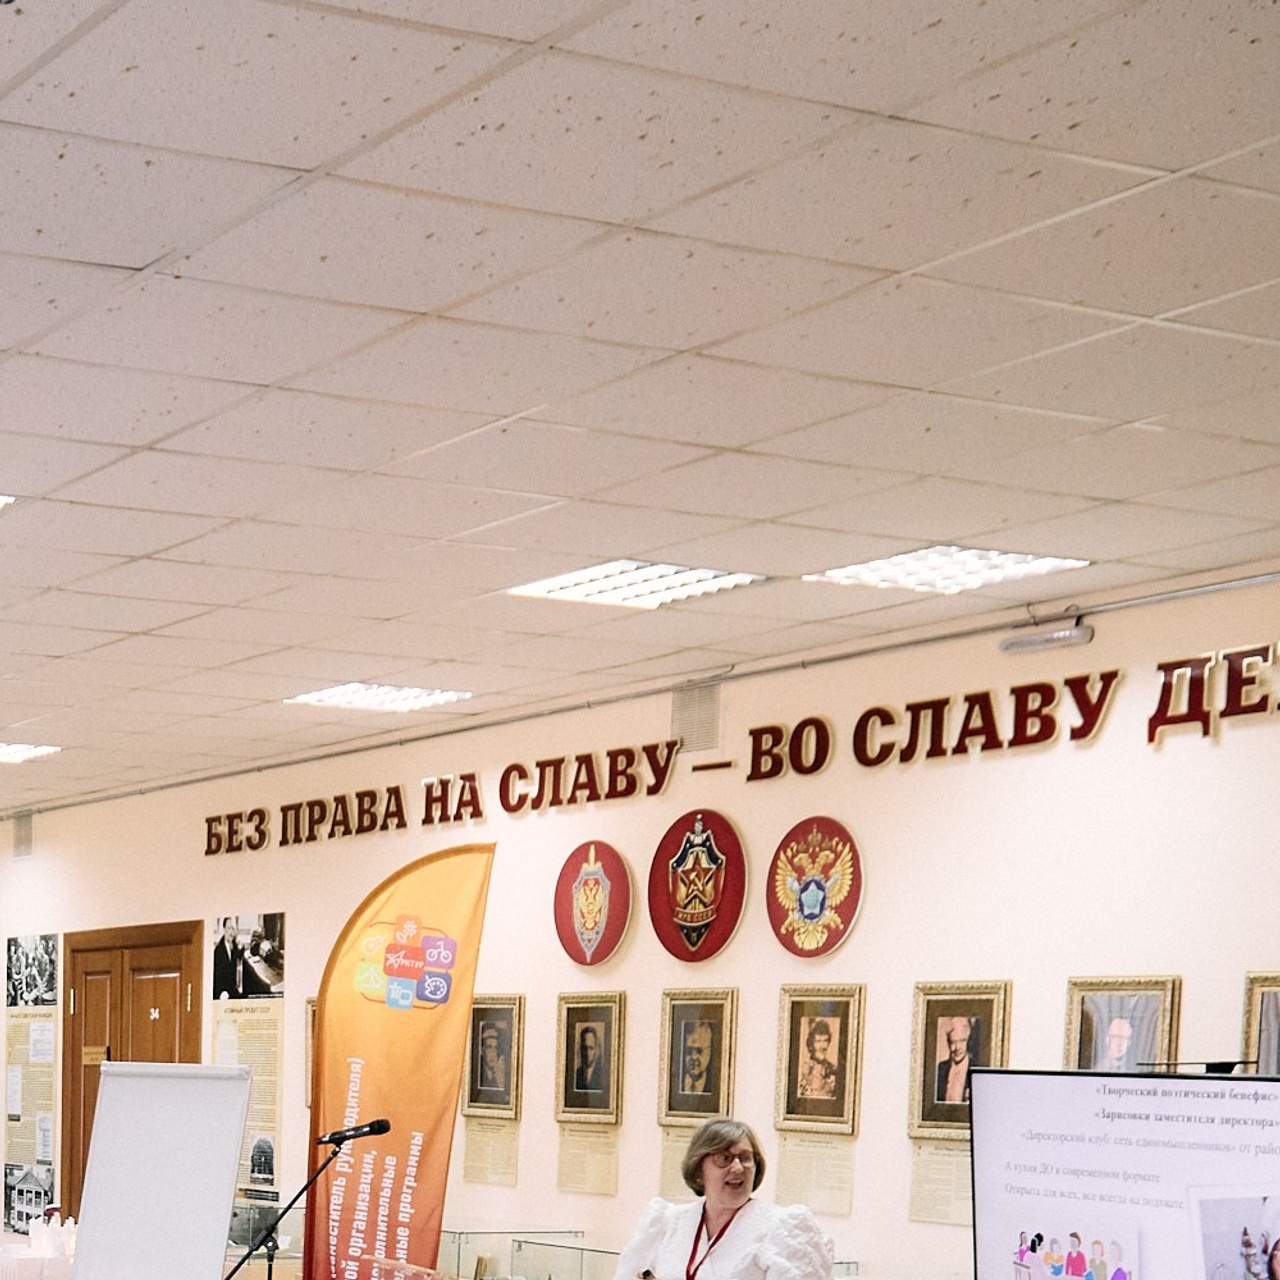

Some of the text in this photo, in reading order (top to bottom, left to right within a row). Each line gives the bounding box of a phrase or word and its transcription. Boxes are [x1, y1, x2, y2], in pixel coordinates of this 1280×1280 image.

[204, 808, 267, 856] БЕЗ
[279, 784, 407, 847] ПРАВА
[421, 772, 483, 826] НА
[498, 739, 678, 813] СЛАВУ
[746, 716, 831, 782] ВО
[852, 669, 1120, 768] СЛАВУ
[1147, 644, 1280, 743] ДЕ
[347, 1149, 377, 1257] организации,
[397, 1131, 424, 1222] программы
